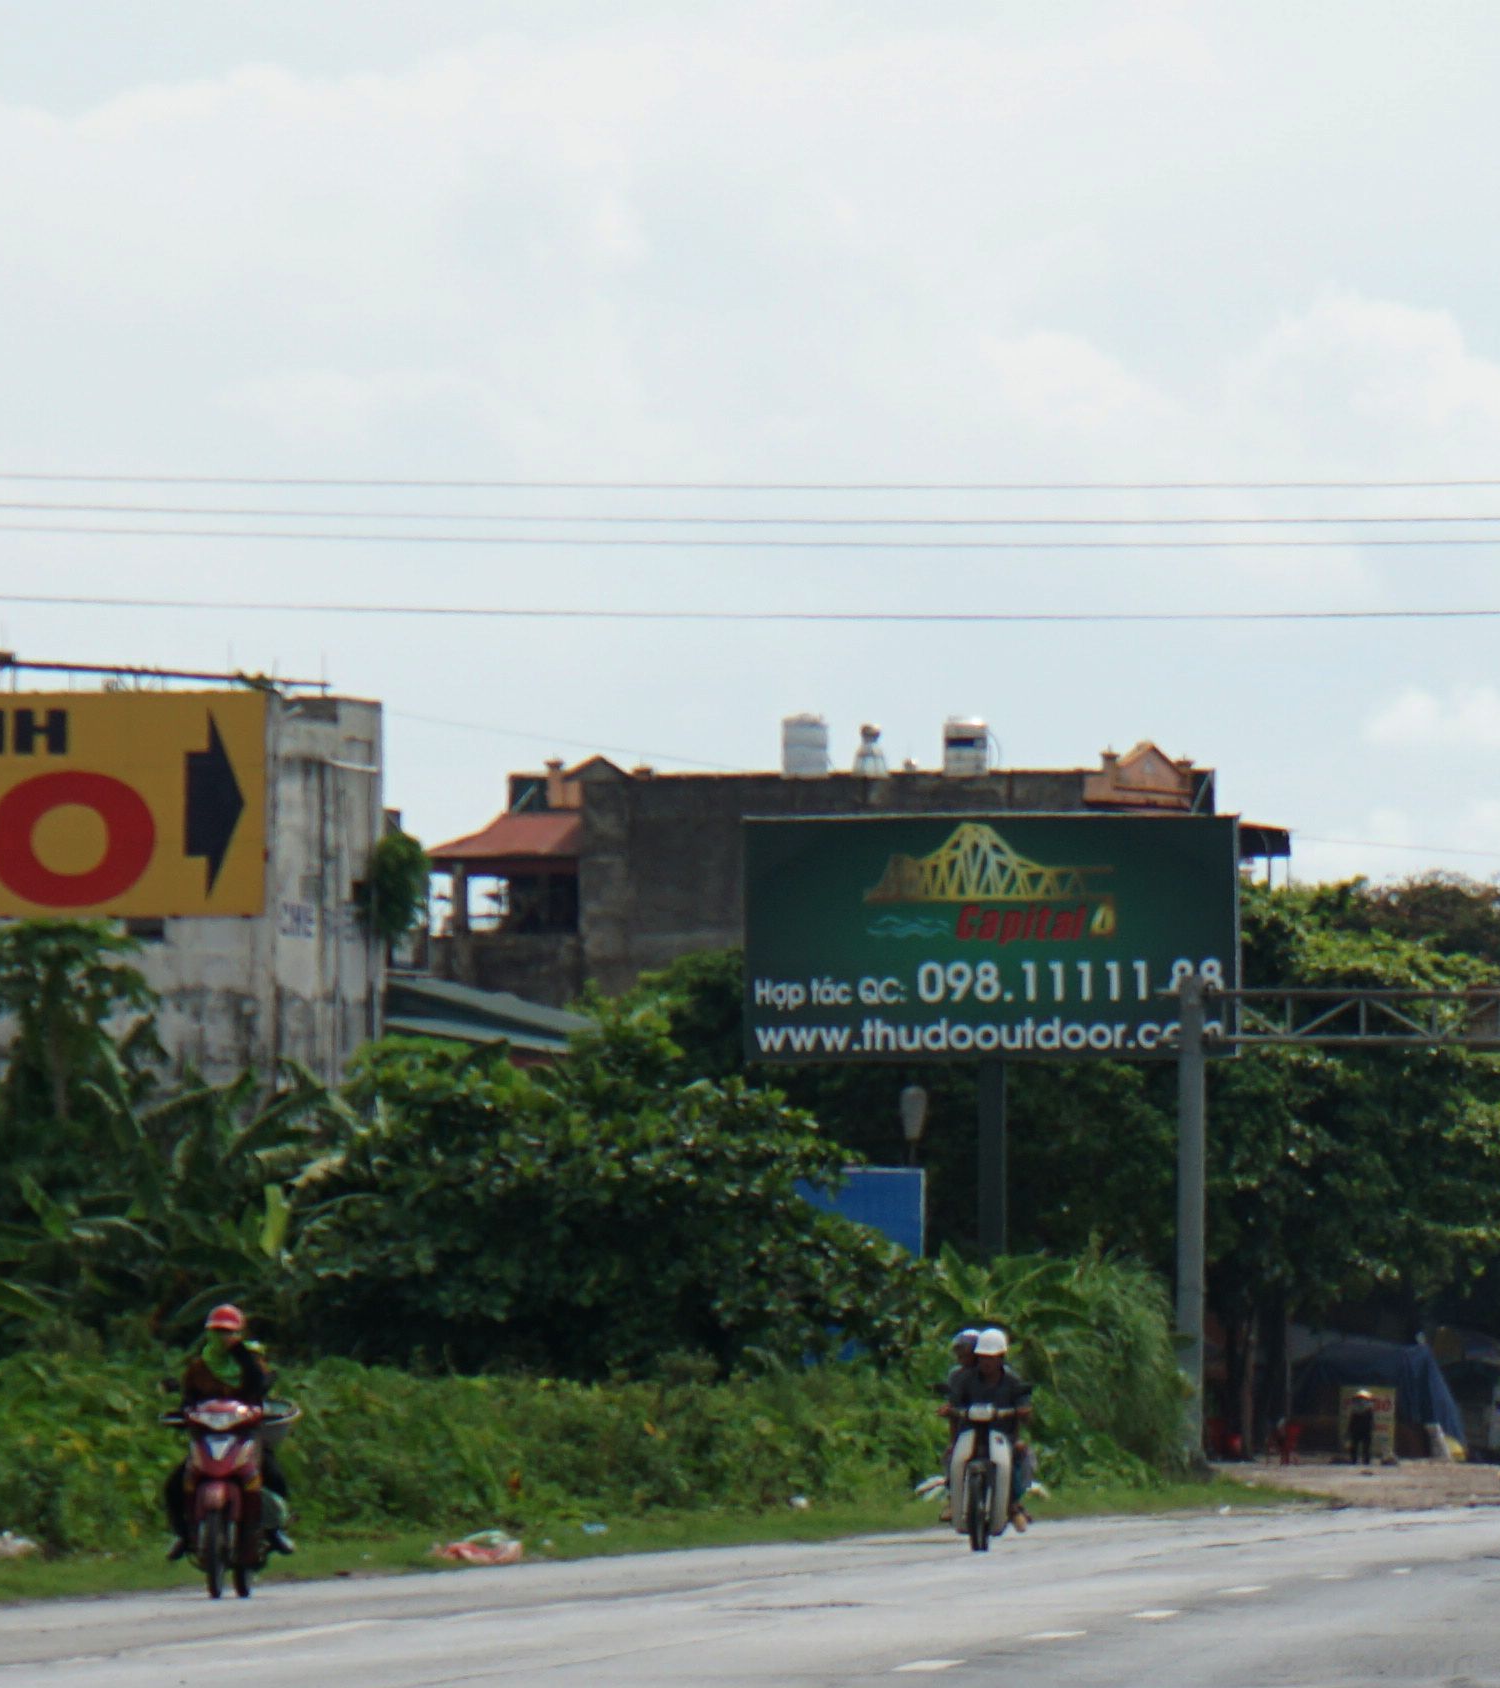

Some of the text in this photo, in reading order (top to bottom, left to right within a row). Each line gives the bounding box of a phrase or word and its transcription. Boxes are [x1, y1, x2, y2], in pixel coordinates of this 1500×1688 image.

[956, 904, 1088, 947] Capital
[755, 978, 806, 1010] Hợp
[810, 976, 852, 1005] tác
[858, 976, 907, 1005] QC:
